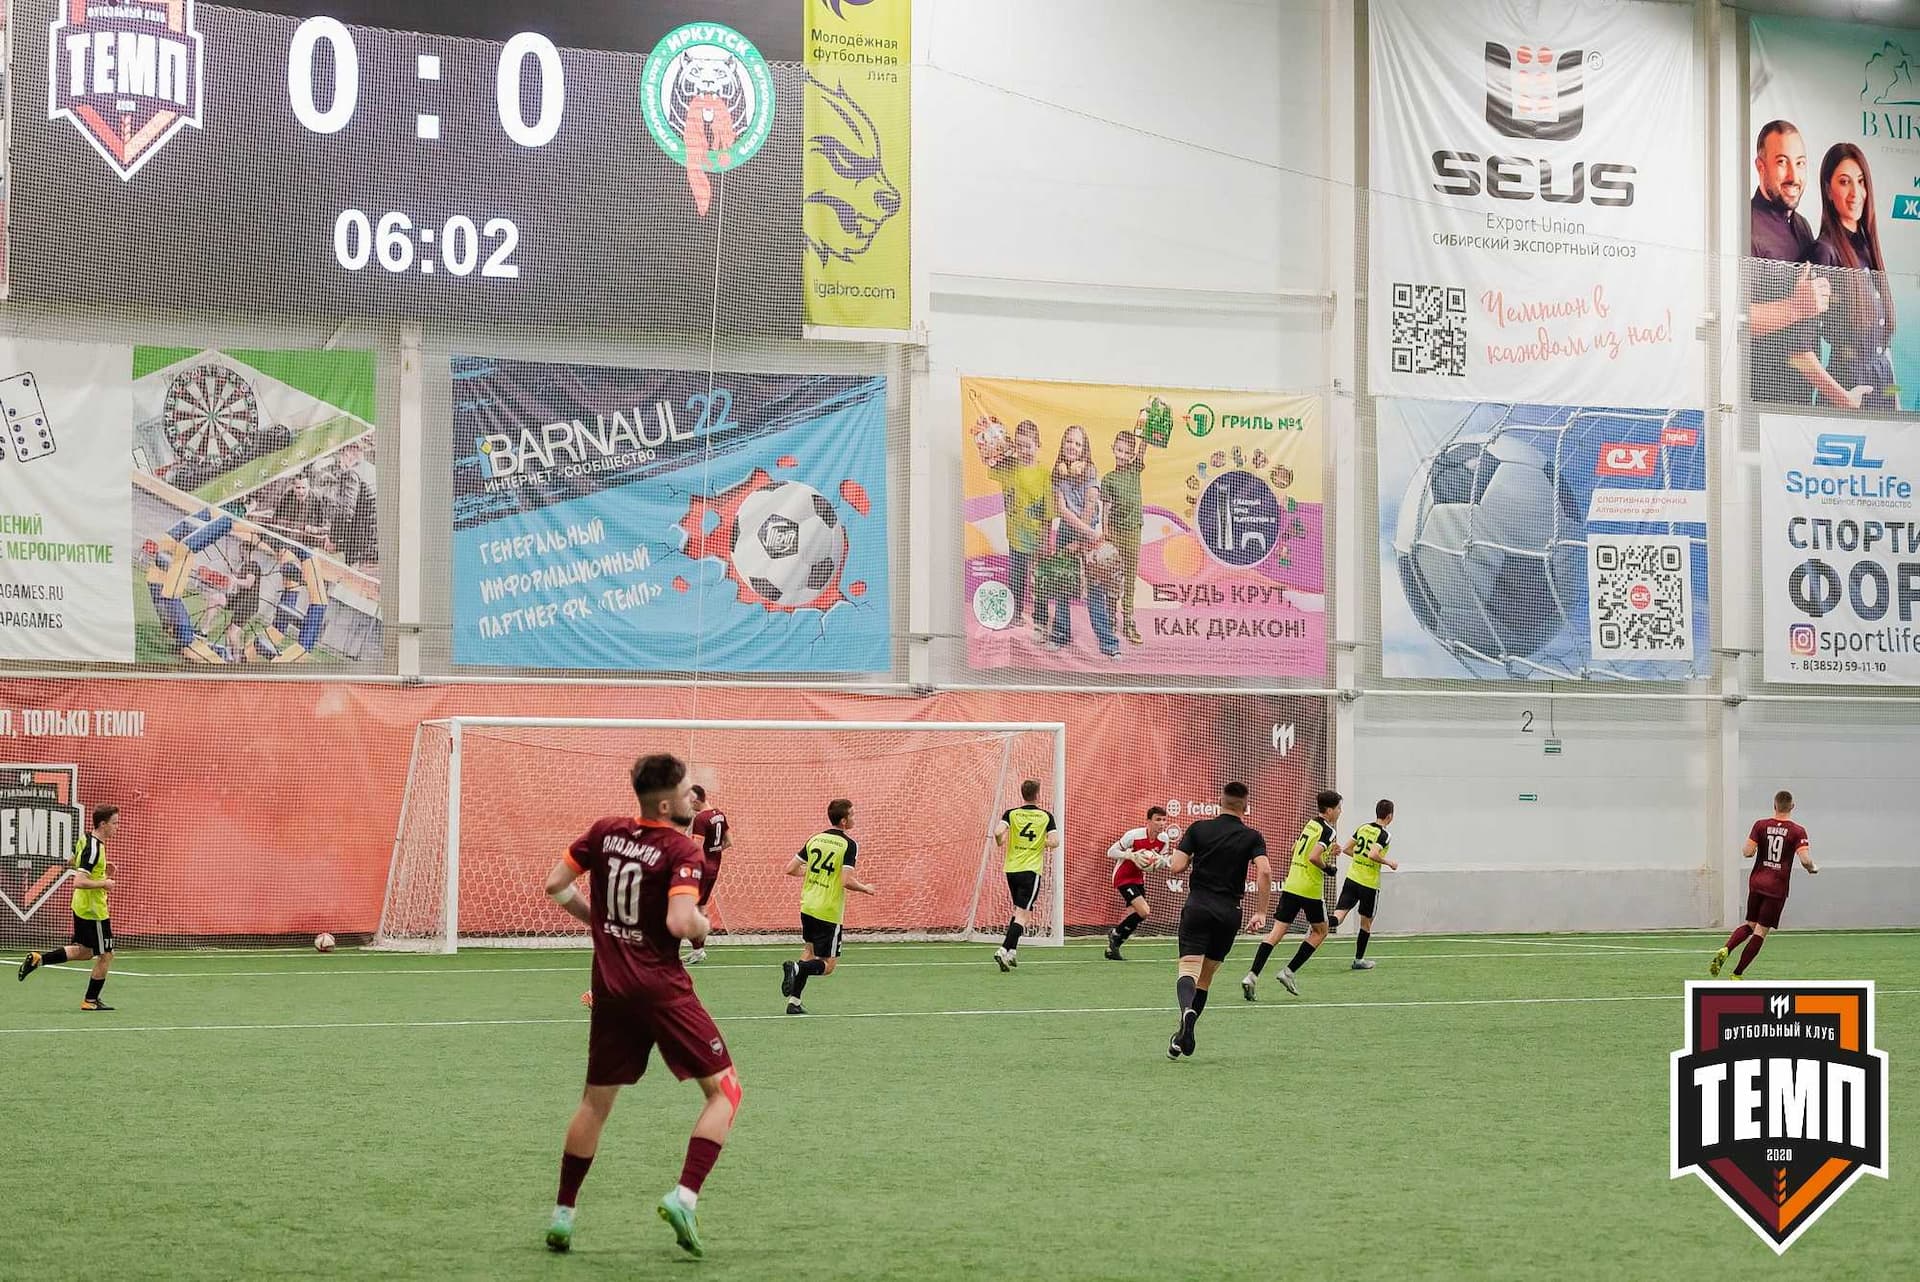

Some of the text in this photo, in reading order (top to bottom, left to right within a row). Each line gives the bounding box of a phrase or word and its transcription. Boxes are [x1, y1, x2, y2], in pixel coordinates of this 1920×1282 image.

[665, 26, 748, 57] ИРКУТСК
[811, 28, 898, 50] Молодёжная
[66, 31, 187, 106] ТЕМП
[813, 47, 898, 66] футбольная
[288, 16, 359, 133] 0
[498, 32, 564, 147] 0
[1432, 150, 1637, 207] SEUS
[1486, 212, 1585, 235] Export Union
[334, 209, 519, 278] 06:02
[1432, 232, 1636, 258] СИБИРСКИЙ ЭКСПОРТНЫЙ СОЮЗ
[1481, 290, 1589, 328] Чемпион
[1487, 309, 1673, 364] каждом из нас!
[1221, 415, 1273, 430] ГРИЛЬ
[1812, 433, 1884, 468] SL
[484, 469, 553, 493] ИНТЕРНЕТ
[564, 448, 656, 478] СООБЩЕСТВО
[1786, 470, 1911, 499] SportLife
[7, 541, 113, 563] МЕРОПРИЯТИЕ
[479, 516, 606, 565] ГЕНЕРАЛЬНЫЙ
[479, 543, 651, 604] ИНФОРМАЦИОННЫЙ
[1153, 583, 1292, 608] БУДЬ КРУТ,
[478, 603, 558, 640] ПАРТНЕР
[562, 596, 593, 621] ФК
[1154, 617, 1306, 640] КАК ДРАКОН!
[1803, 660, 1843, 672] 8(3852)
[1845, 661, 1886, 672] 59-11-10
[22, 710, 89, 736] ТОЛЬКО
[95, 711, 144, 736] ТЕМП!
[1521, 710, 1534, 733] 2
[1019, 822, 1036, 842] 4
[810, 848, 835, 876] 24
[1767, 834, 1784, 863] 19
[606, 857, 643, 926] 10
